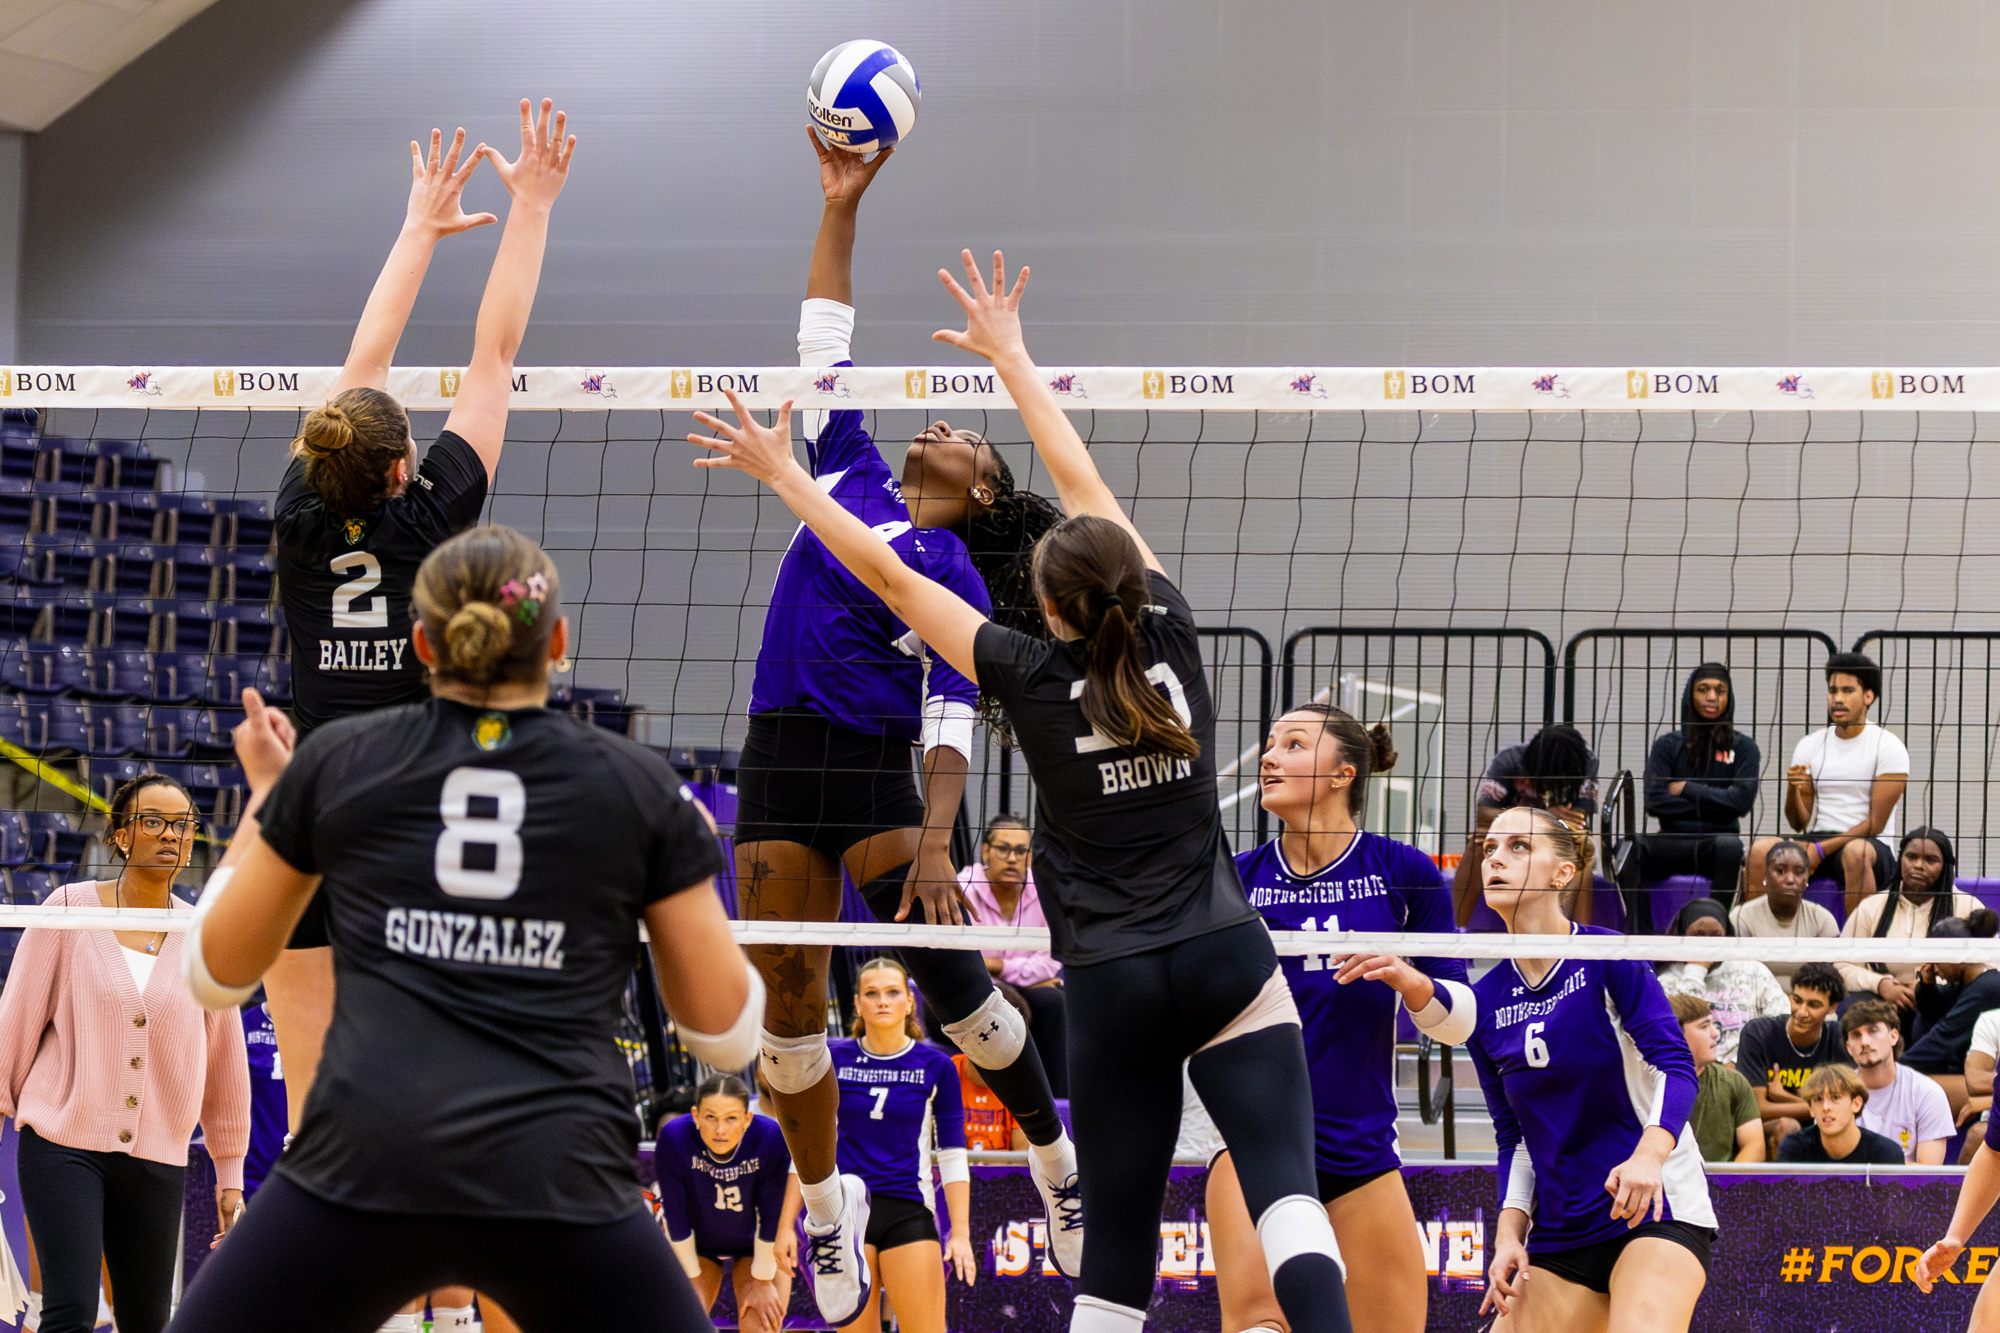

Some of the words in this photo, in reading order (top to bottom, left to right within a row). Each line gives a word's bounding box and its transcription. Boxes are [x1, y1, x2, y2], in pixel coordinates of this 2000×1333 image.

[808, 98, 852, 128] molten
[16, 373, 76, 391] BOM
[238, 373, 299, 391] BOM
[697, 375, 759, 393] BOM
[931, 375, 995, 393] BOM
[1170, 375, 1234, 393] BOM
[1411, 375, 1474, 393] BOM
[1654, 375, 1718, 393] BOM
[1900, 375, 1964, 393] BOM
[330, 551, 388, 628] 2
[318, 638, 407, 671] BAILEY
[1098, 752, 1192, 795] BROWN
[435, 766, 526, 900] 8
[1348, 875, 1387, 899] STATE
[386, 907, 566, 969] GONZALEZ
[1525, 1021, 1550, 1068] 6
[900, 1068, 925, 1084] STATE
[869, 1087, 889, 1120] 7
[714, 1183, 744, 1212] 12
